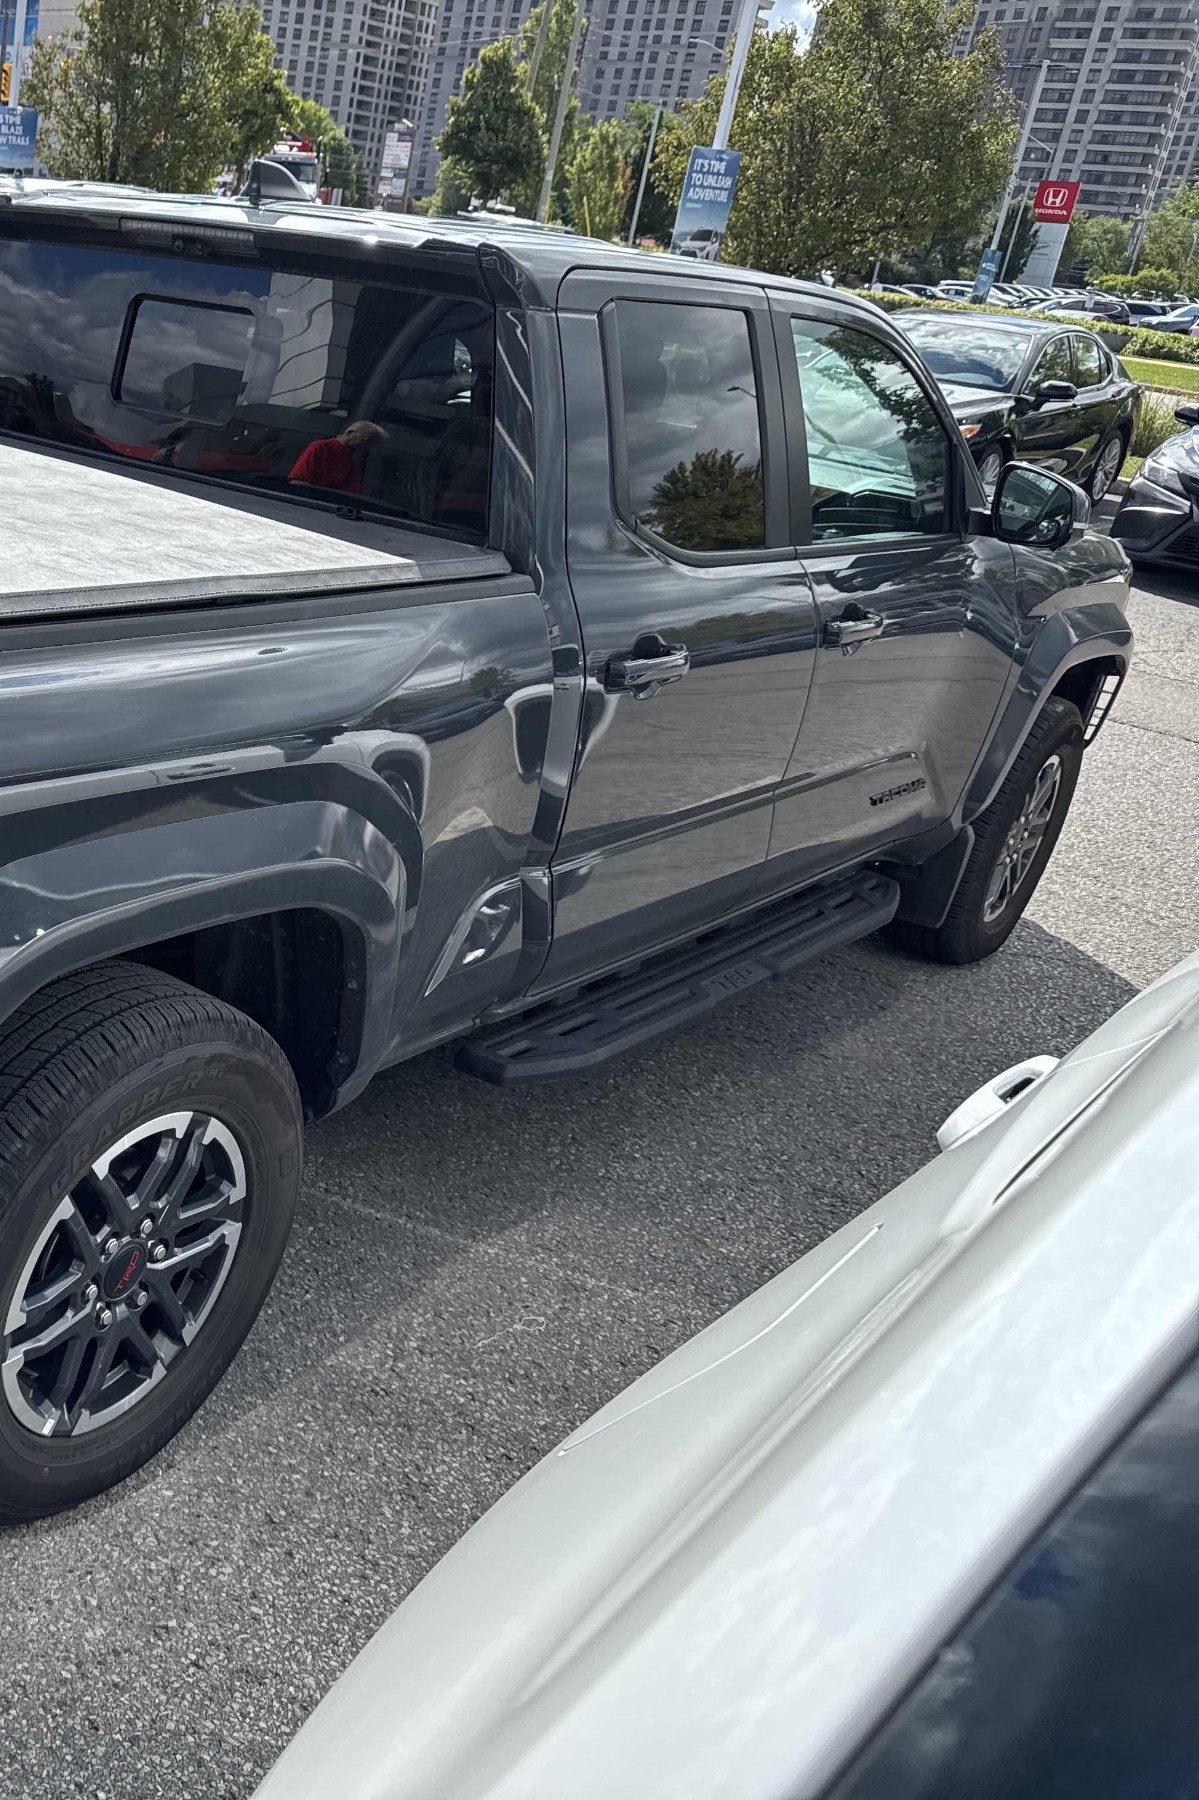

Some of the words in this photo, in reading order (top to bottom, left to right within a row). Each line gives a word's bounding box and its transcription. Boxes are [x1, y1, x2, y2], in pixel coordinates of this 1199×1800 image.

[5, 115, 21, 125] TIME
[1, 125, 23, 135] BLAZE
[8, 136, 30, 146] TRAILS
[693, 159, 709, 172] IT'S
[710, 160, 727, 174] TIME
[691, 173, 703, 185] TO
[703, 174, 733, 189] UNLEASH
[687, 187, 729, 202] ADVENTURE
[1035, 208, 1068, 216] HONDA
[869, 778, 927, 807] TACOMA
[113, 1250, 140, 1293] TRD
